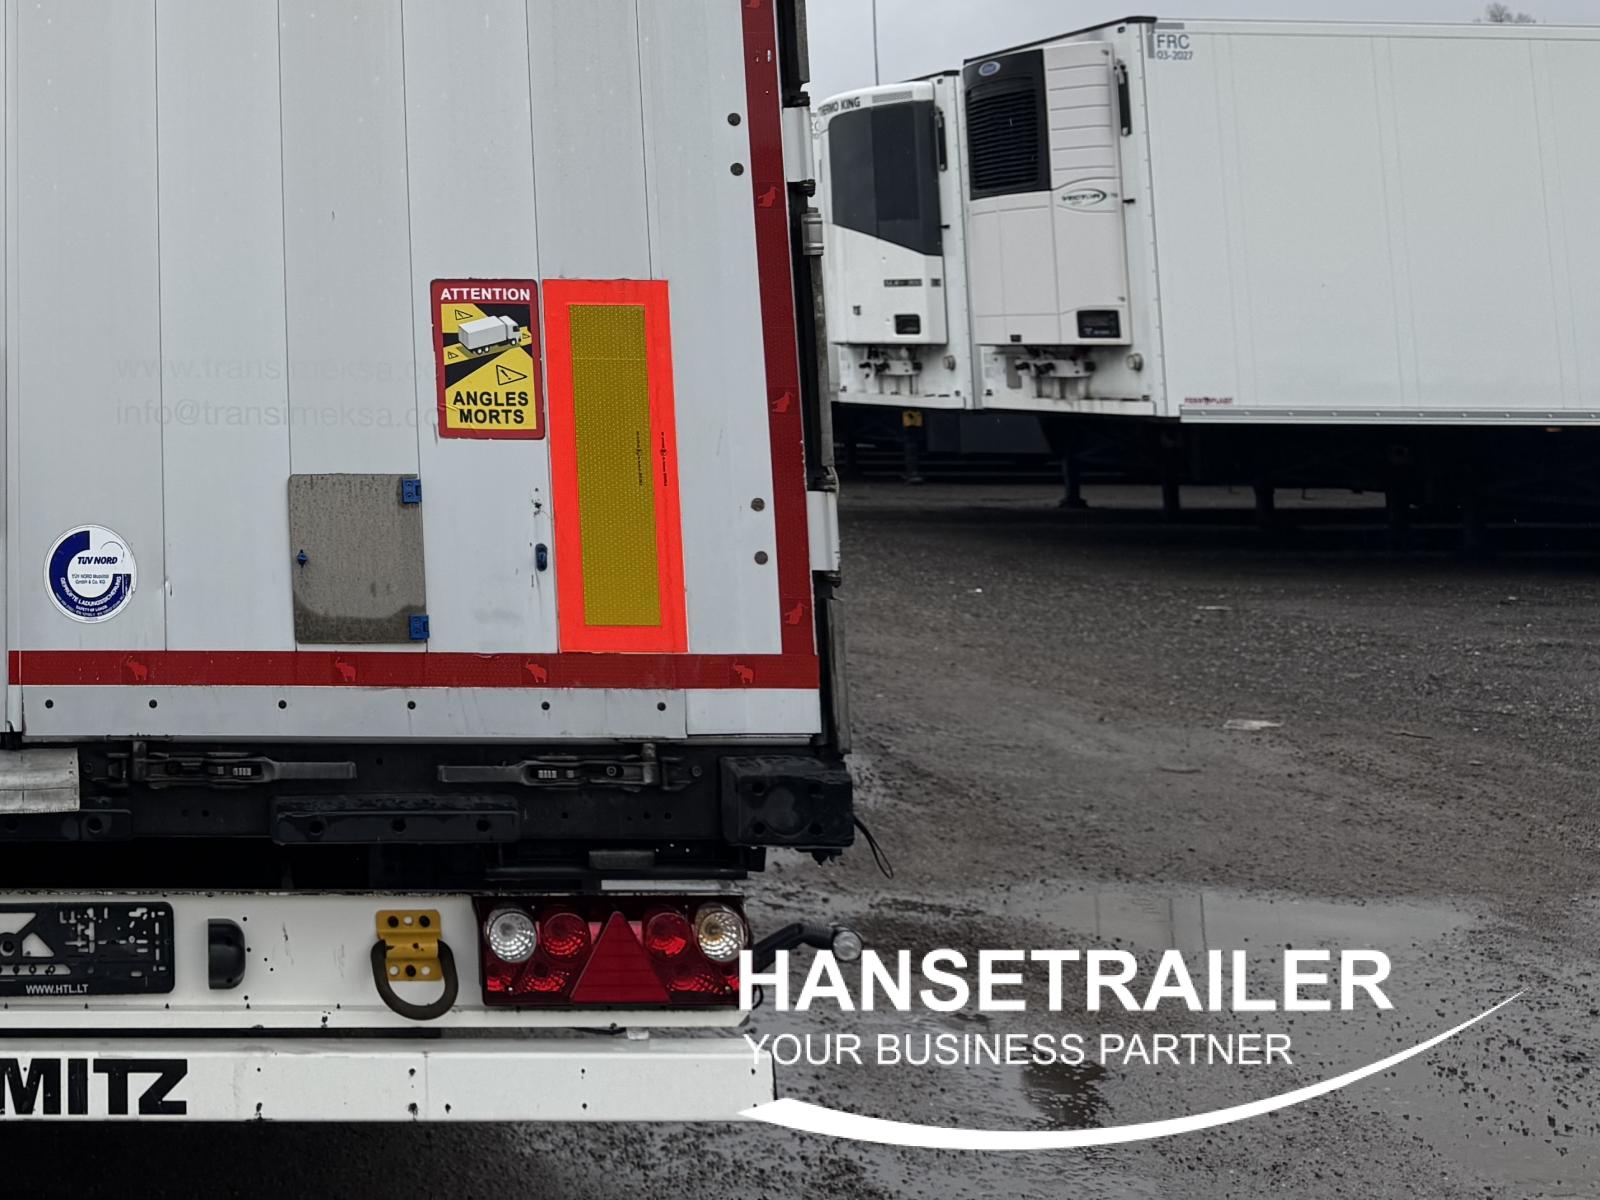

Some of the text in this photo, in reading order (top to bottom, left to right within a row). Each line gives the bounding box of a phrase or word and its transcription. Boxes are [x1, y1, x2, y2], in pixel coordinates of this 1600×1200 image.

[1157, 34, 1190, 49] FRC
[841, 96, 861, 110] KING
[440, 288, 530, 301] ATTENTION
[453, 391, 529, 406] ANGLES
[115, 398, 436, 426] info@transimeksa.co
[459, 409, 525, 424] MORTS
[94, 556, 118, 565] NORD
[25, 984, 89, 994] WWW.HTL.LT
